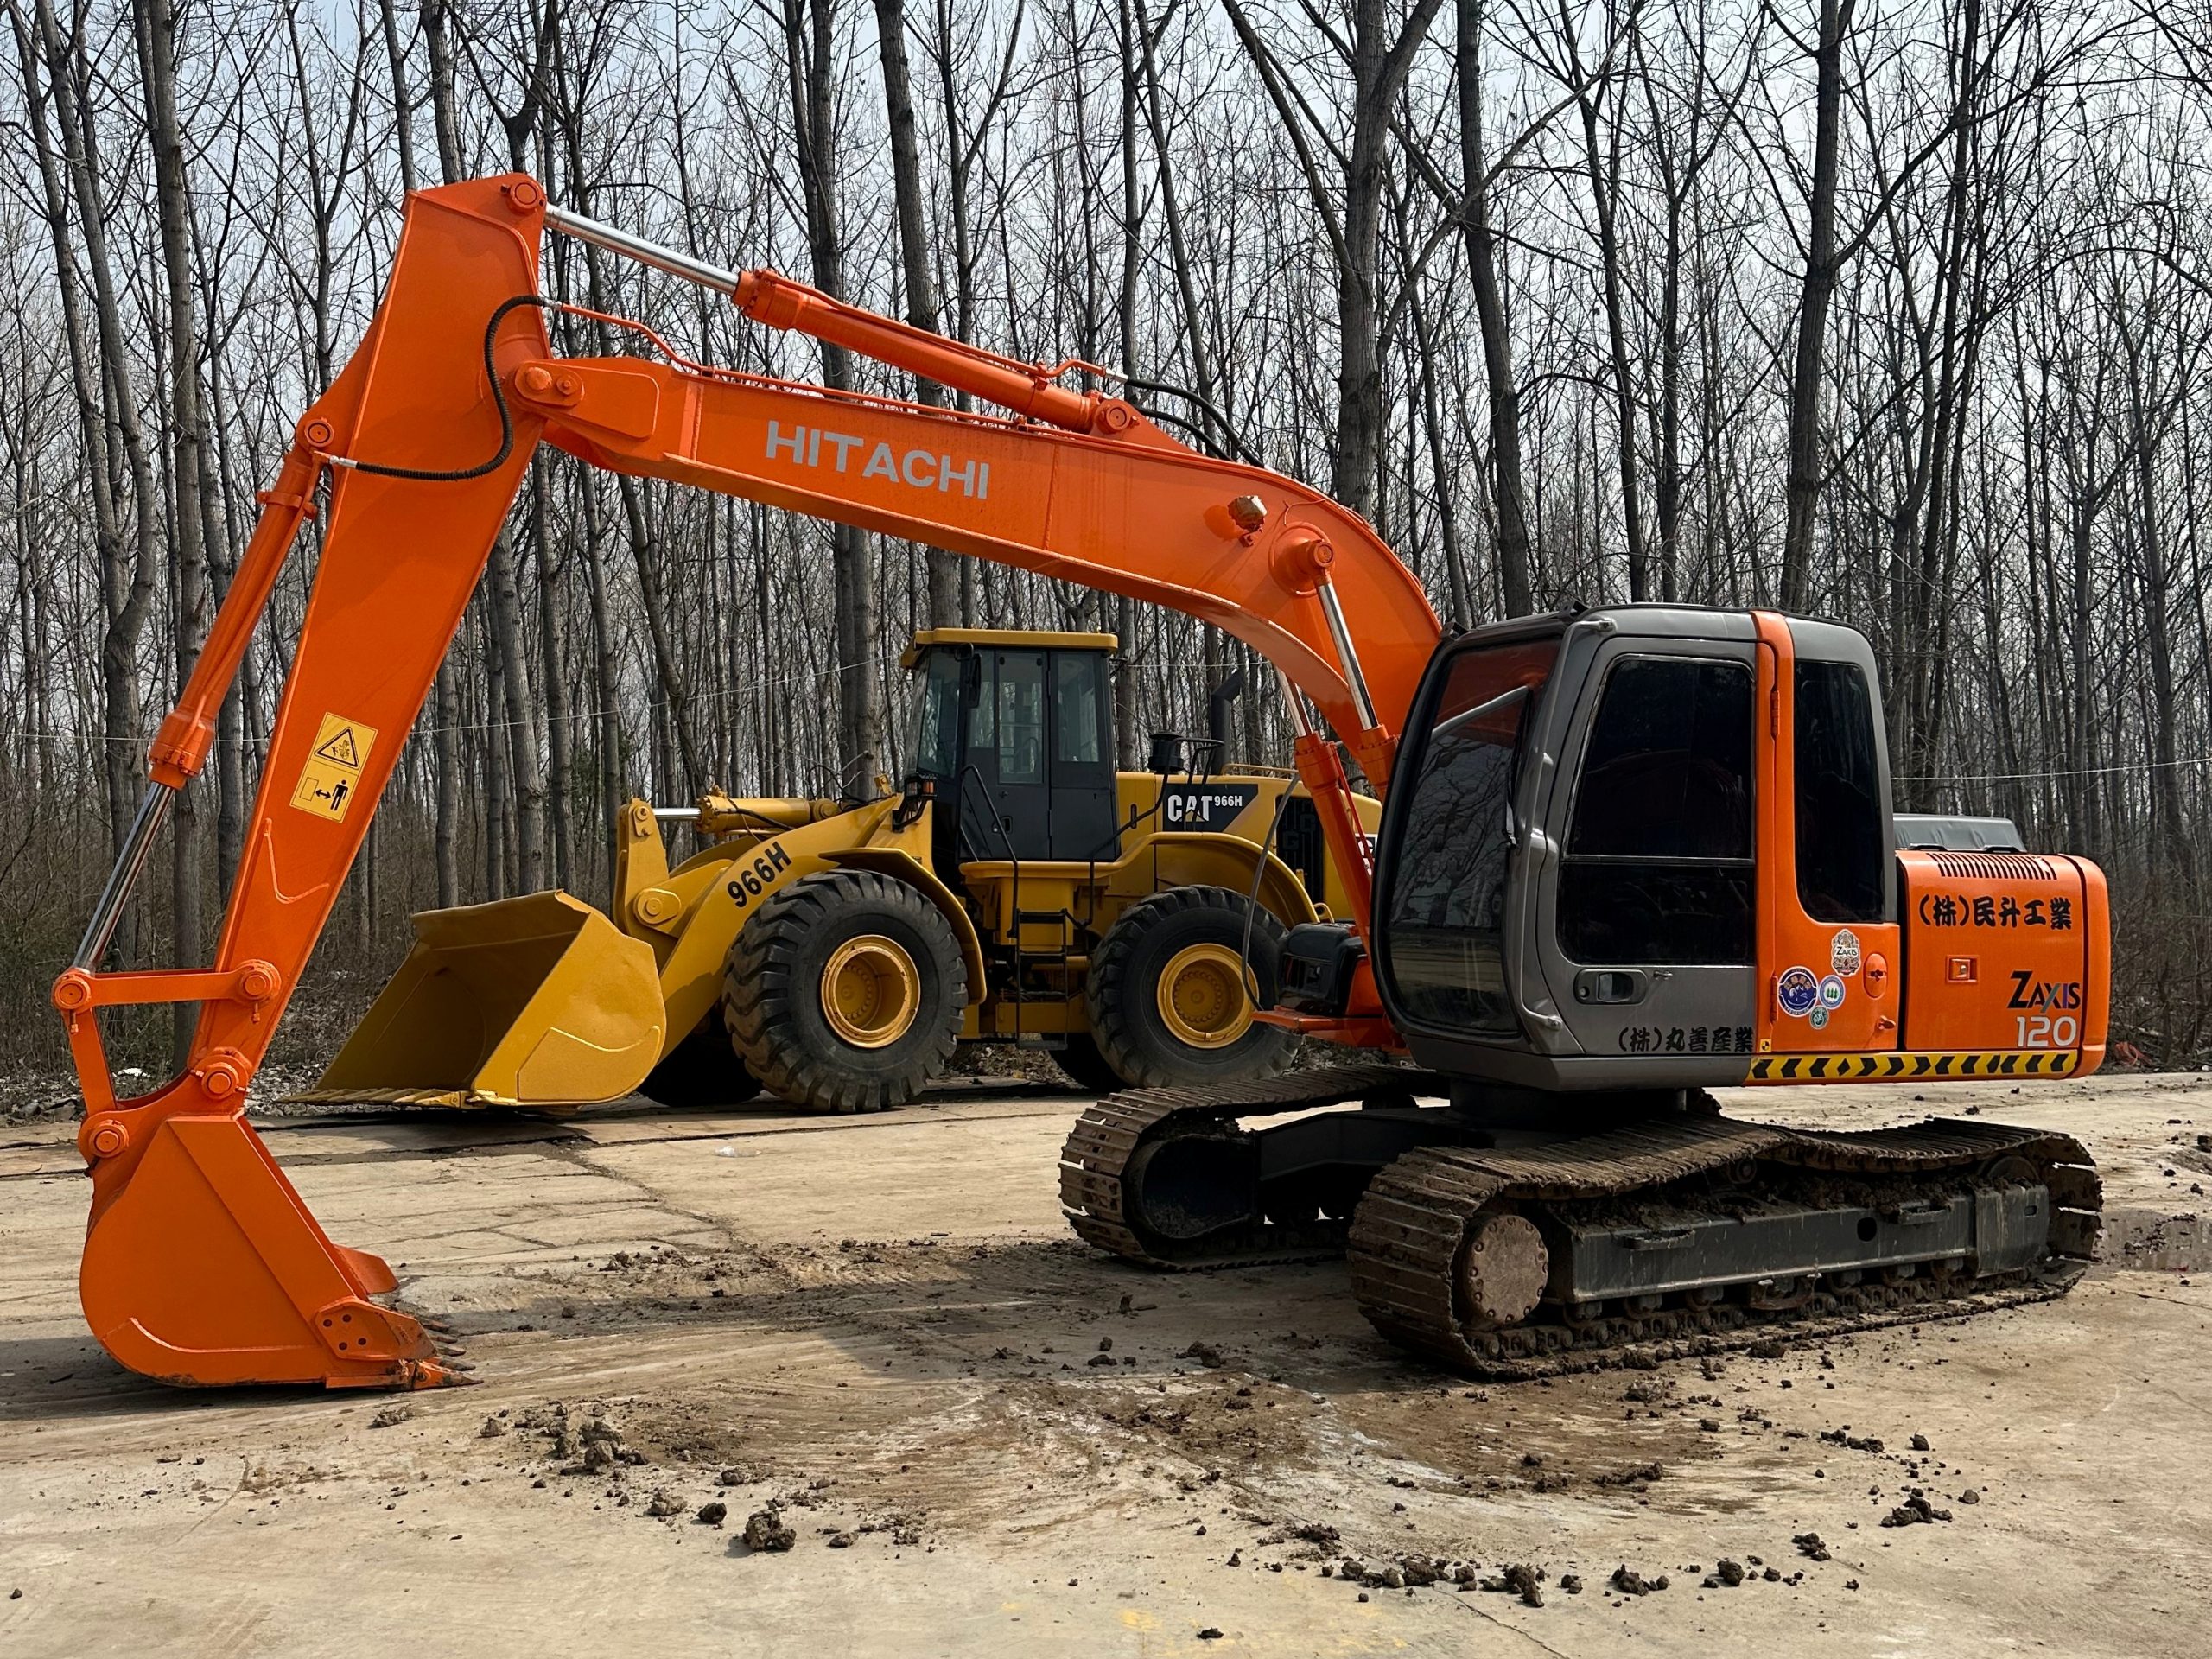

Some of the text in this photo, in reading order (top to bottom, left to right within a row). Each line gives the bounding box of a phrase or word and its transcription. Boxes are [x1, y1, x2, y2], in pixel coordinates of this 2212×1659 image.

[766, 420, 989, 499] HITACHI
[1168, 795, 1243, 822] CAT 966H
[728, 841, 792, 908] 966H
[2007, 970, 2081, 1013] ZAXIS
[2017, 1016, 2076, 1046] 120
